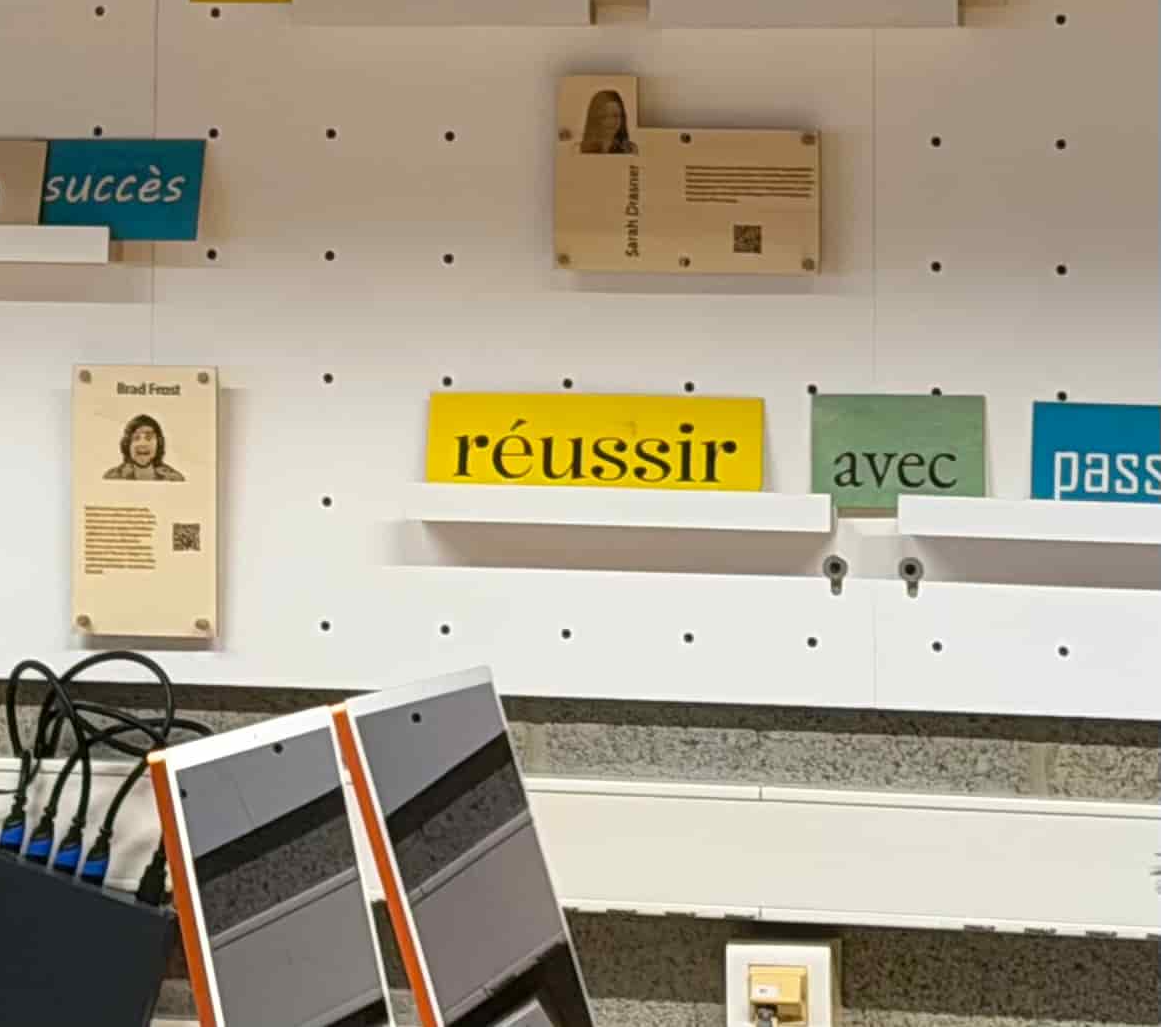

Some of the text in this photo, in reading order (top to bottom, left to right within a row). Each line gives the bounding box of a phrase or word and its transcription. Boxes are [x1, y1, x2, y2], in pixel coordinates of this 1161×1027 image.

[43, 164, 186, 205] succès
[624, 165, 640, 258] Sarah Drasner
[116, 381, 182, 397] Brad Frost
[451, 418, 738, 483] réussir
[832, 450, 958, 489] avec
[1053, 450, 1161, 502] pass
